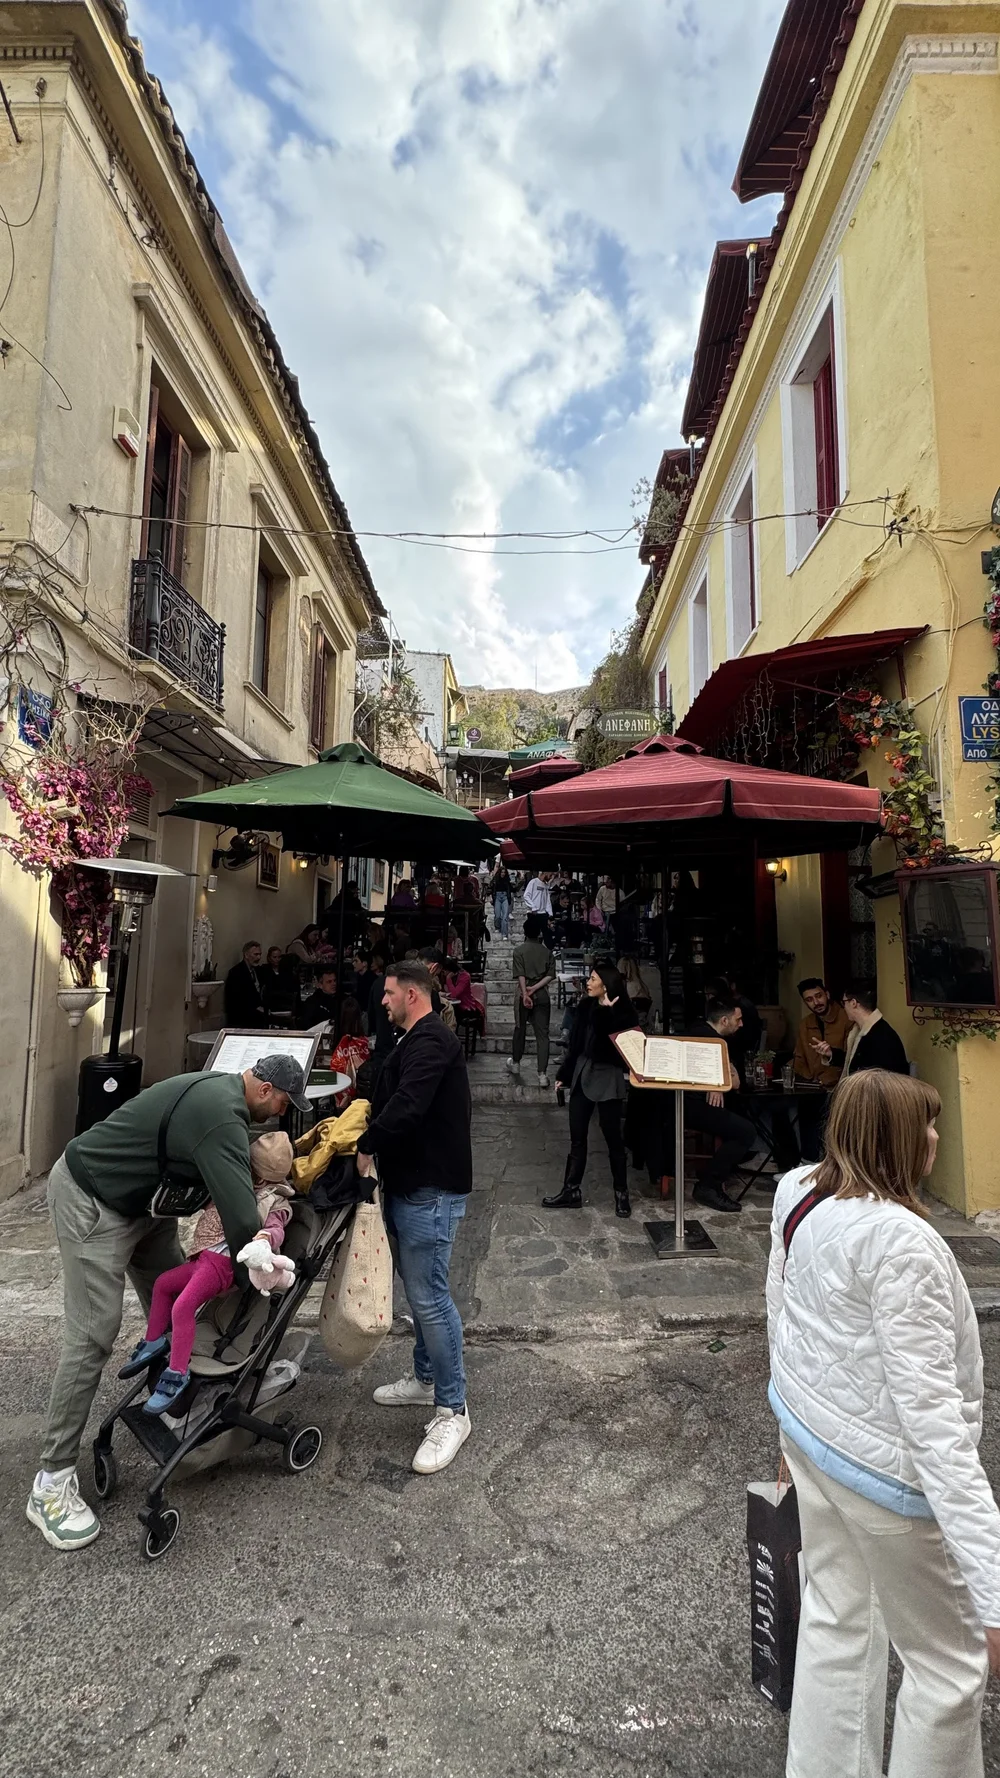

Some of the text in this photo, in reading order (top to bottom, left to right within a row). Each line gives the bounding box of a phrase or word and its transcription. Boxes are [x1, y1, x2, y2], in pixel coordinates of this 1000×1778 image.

[605, 719, 651, 732] ΑΝΕΦΑΝΗ
[972, 727, 1000, 739] LYS
[966, 749, 988, 758] ΑΠΟ
